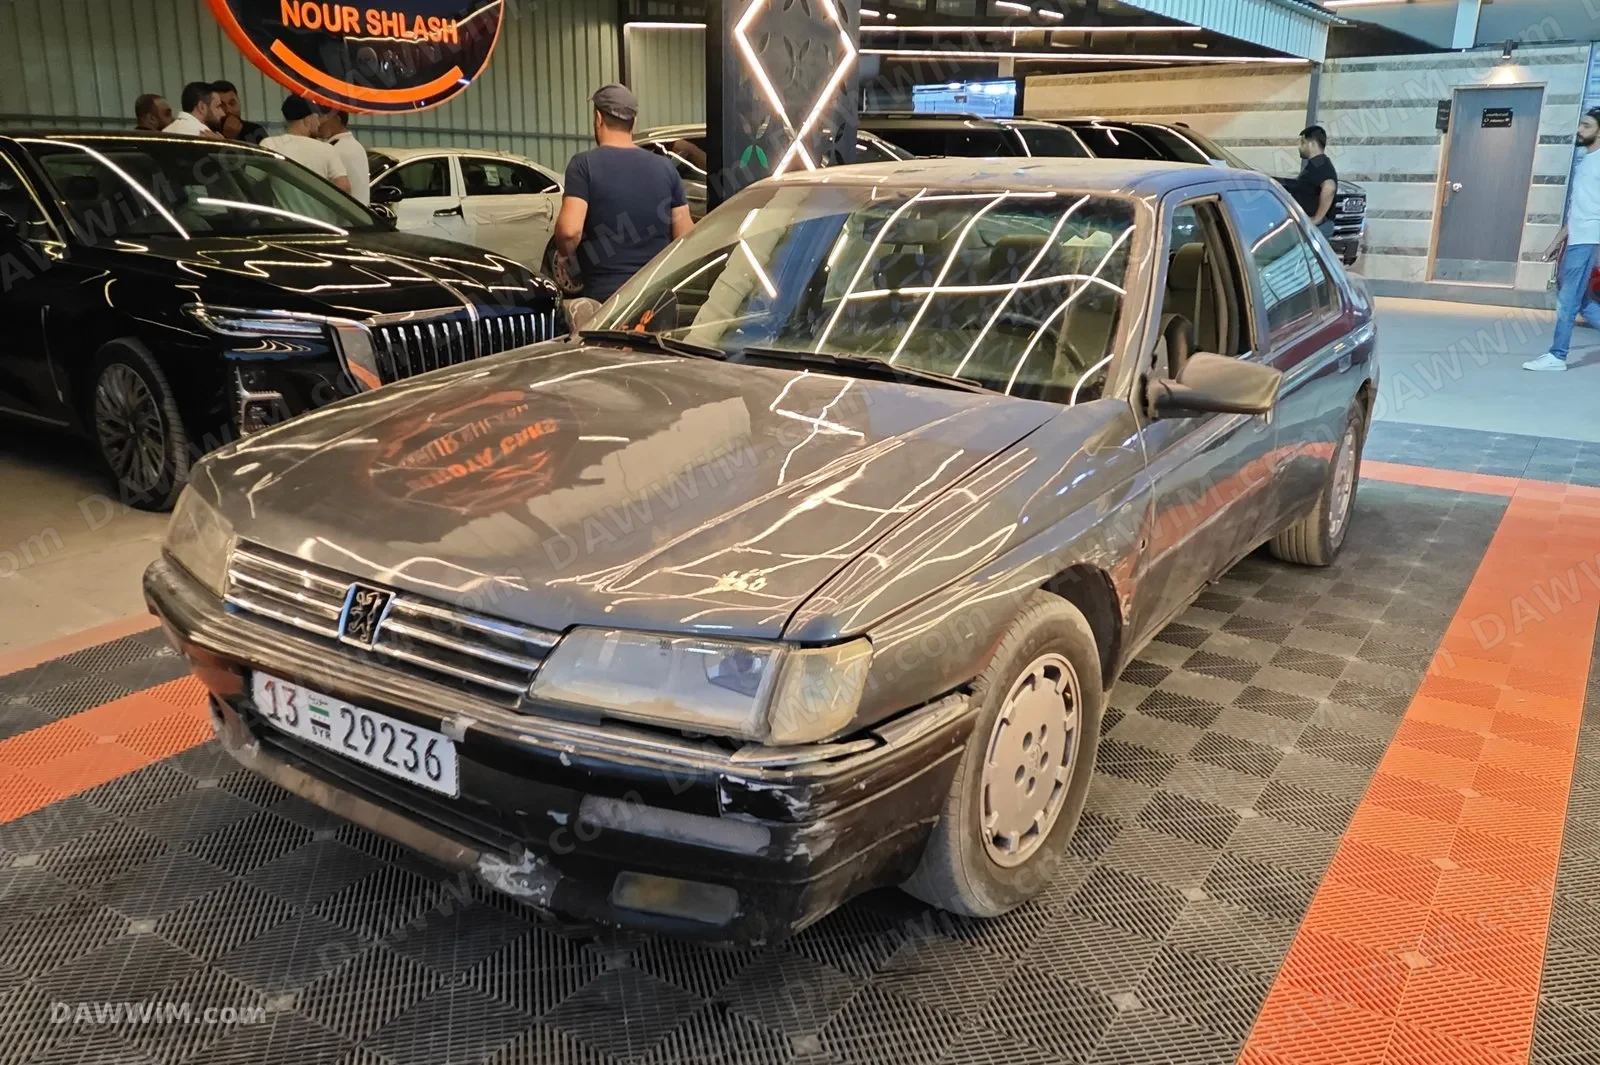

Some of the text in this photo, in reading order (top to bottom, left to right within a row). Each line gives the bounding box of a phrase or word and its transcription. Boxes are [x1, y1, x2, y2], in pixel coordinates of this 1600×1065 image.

[280, 0, 459, 45] NOUR SHLASH
[264, 680, 441, 782] 13 29236
[312, 726, 332, 740] SYR
